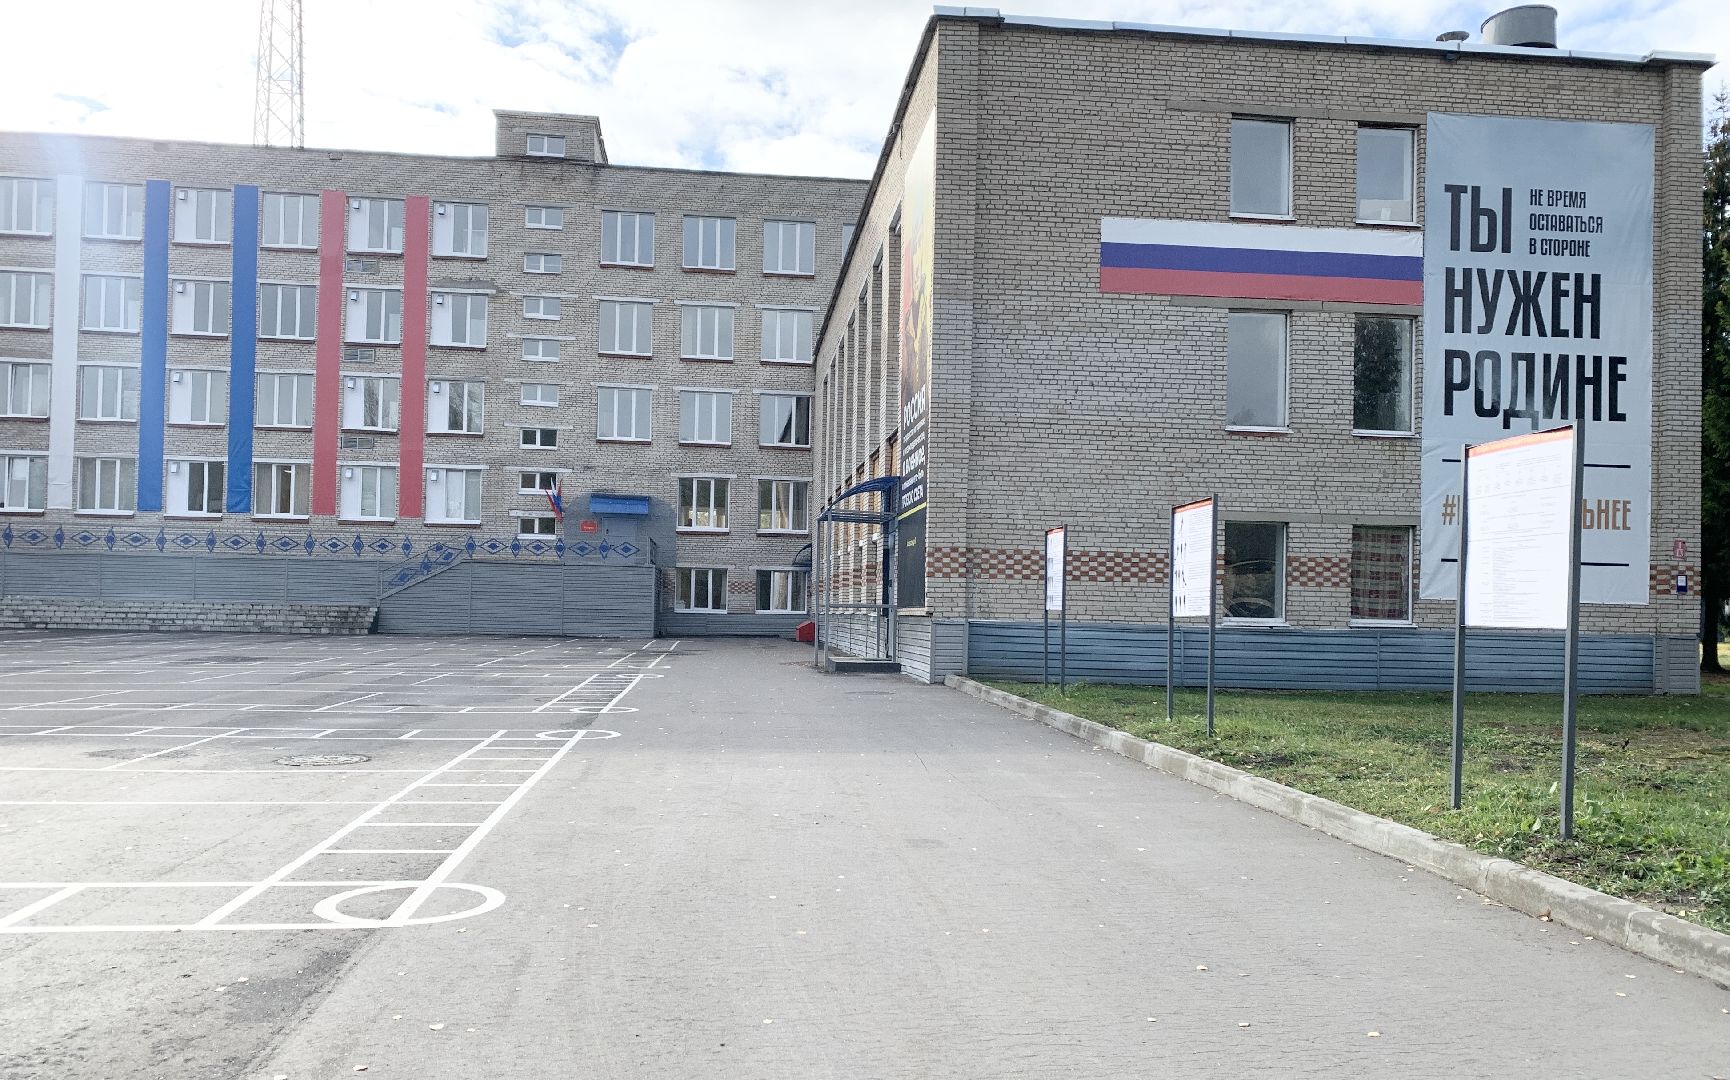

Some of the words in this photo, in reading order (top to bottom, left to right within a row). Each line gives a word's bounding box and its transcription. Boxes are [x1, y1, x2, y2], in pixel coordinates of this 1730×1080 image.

[1444, 184, 1513, 254] ТЫ
[1530, 188, 1543, 207] НЕ
[1547, 189, 1587, 209] ВРЕМЯ
[1529, 213, 1603, 233] ОСТАВАТЬСЯ
[1529, 238, 1537, 255] В
[1540, 239, 1590, 257] СТОРОНЕ
[1444, 266, 1602, 340] НУЖЕН
[903, 383, 926, 431] РОССИЯ
[1443, 348, 1628, 430] РОДИНЕ
